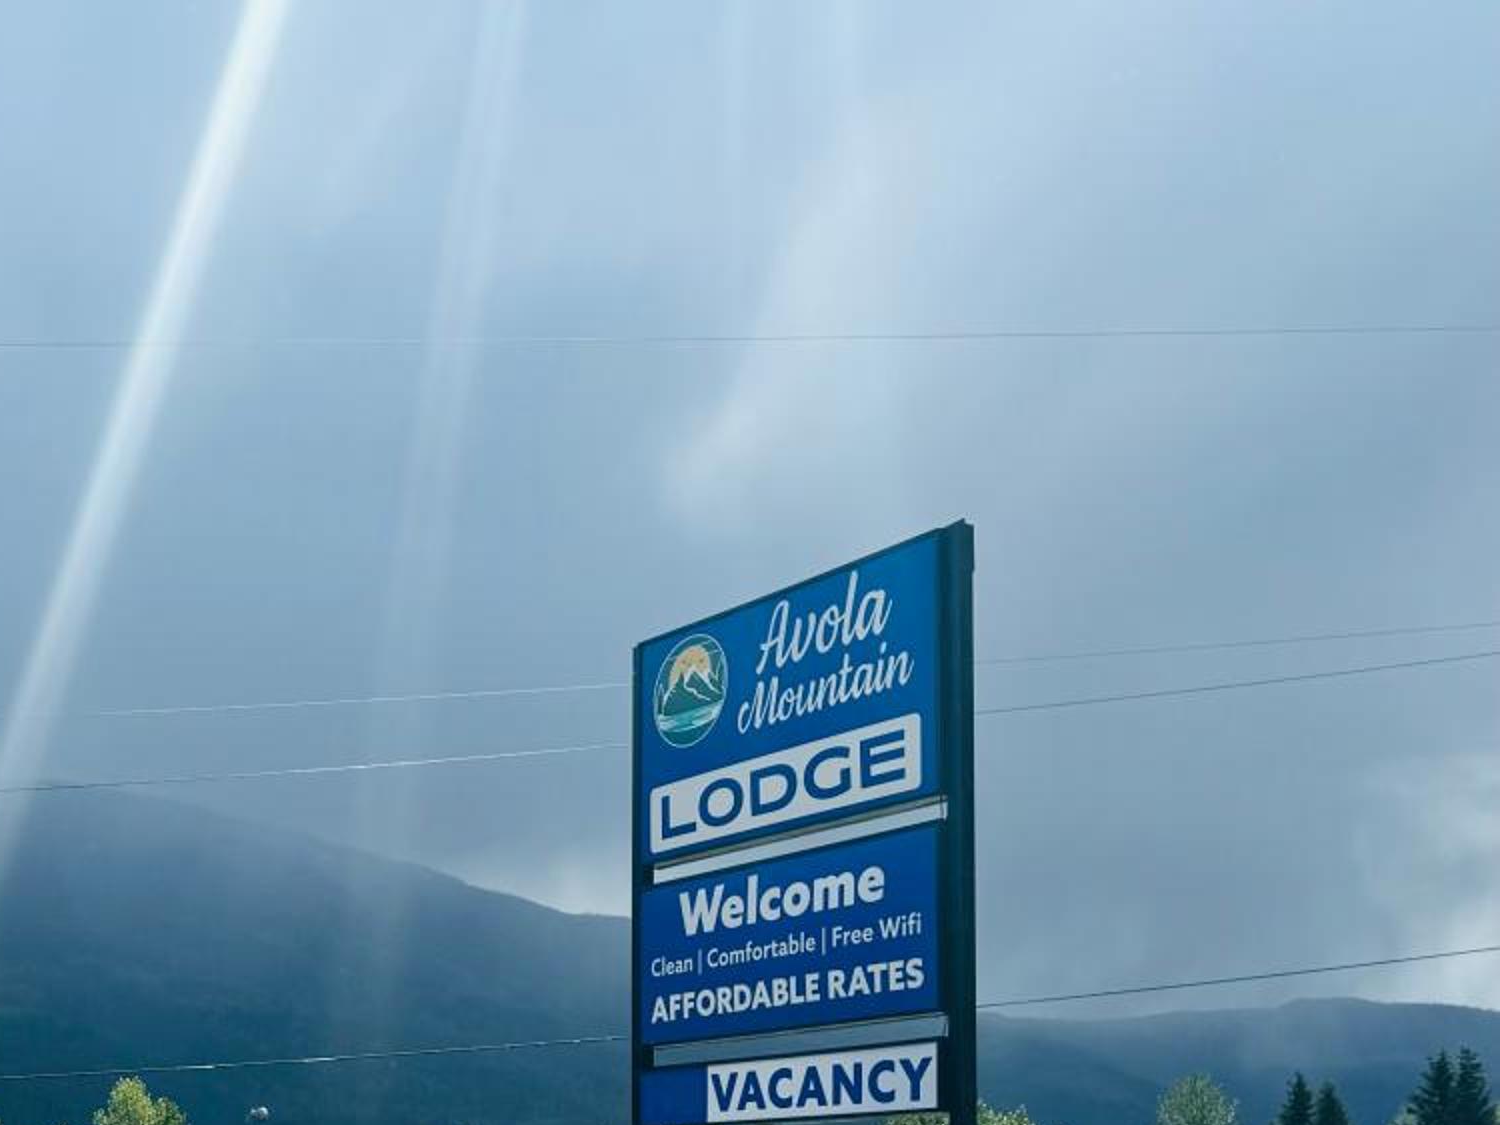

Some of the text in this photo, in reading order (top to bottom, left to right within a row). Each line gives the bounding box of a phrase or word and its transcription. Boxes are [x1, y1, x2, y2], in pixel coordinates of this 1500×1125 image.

[755, 570, 893, 675] Avola
[737, 641, 915, 735] Mountain
[660, 729, 906, 841] LODGE
[679, 865, 885, 937] Welcome
[651, 911, 922, 977] Clean Comfortable Free Wifi
[651, 957, 925, 1024] AFFORDABLE RATES
[710, 1056, 933, 1113] VACANCY
